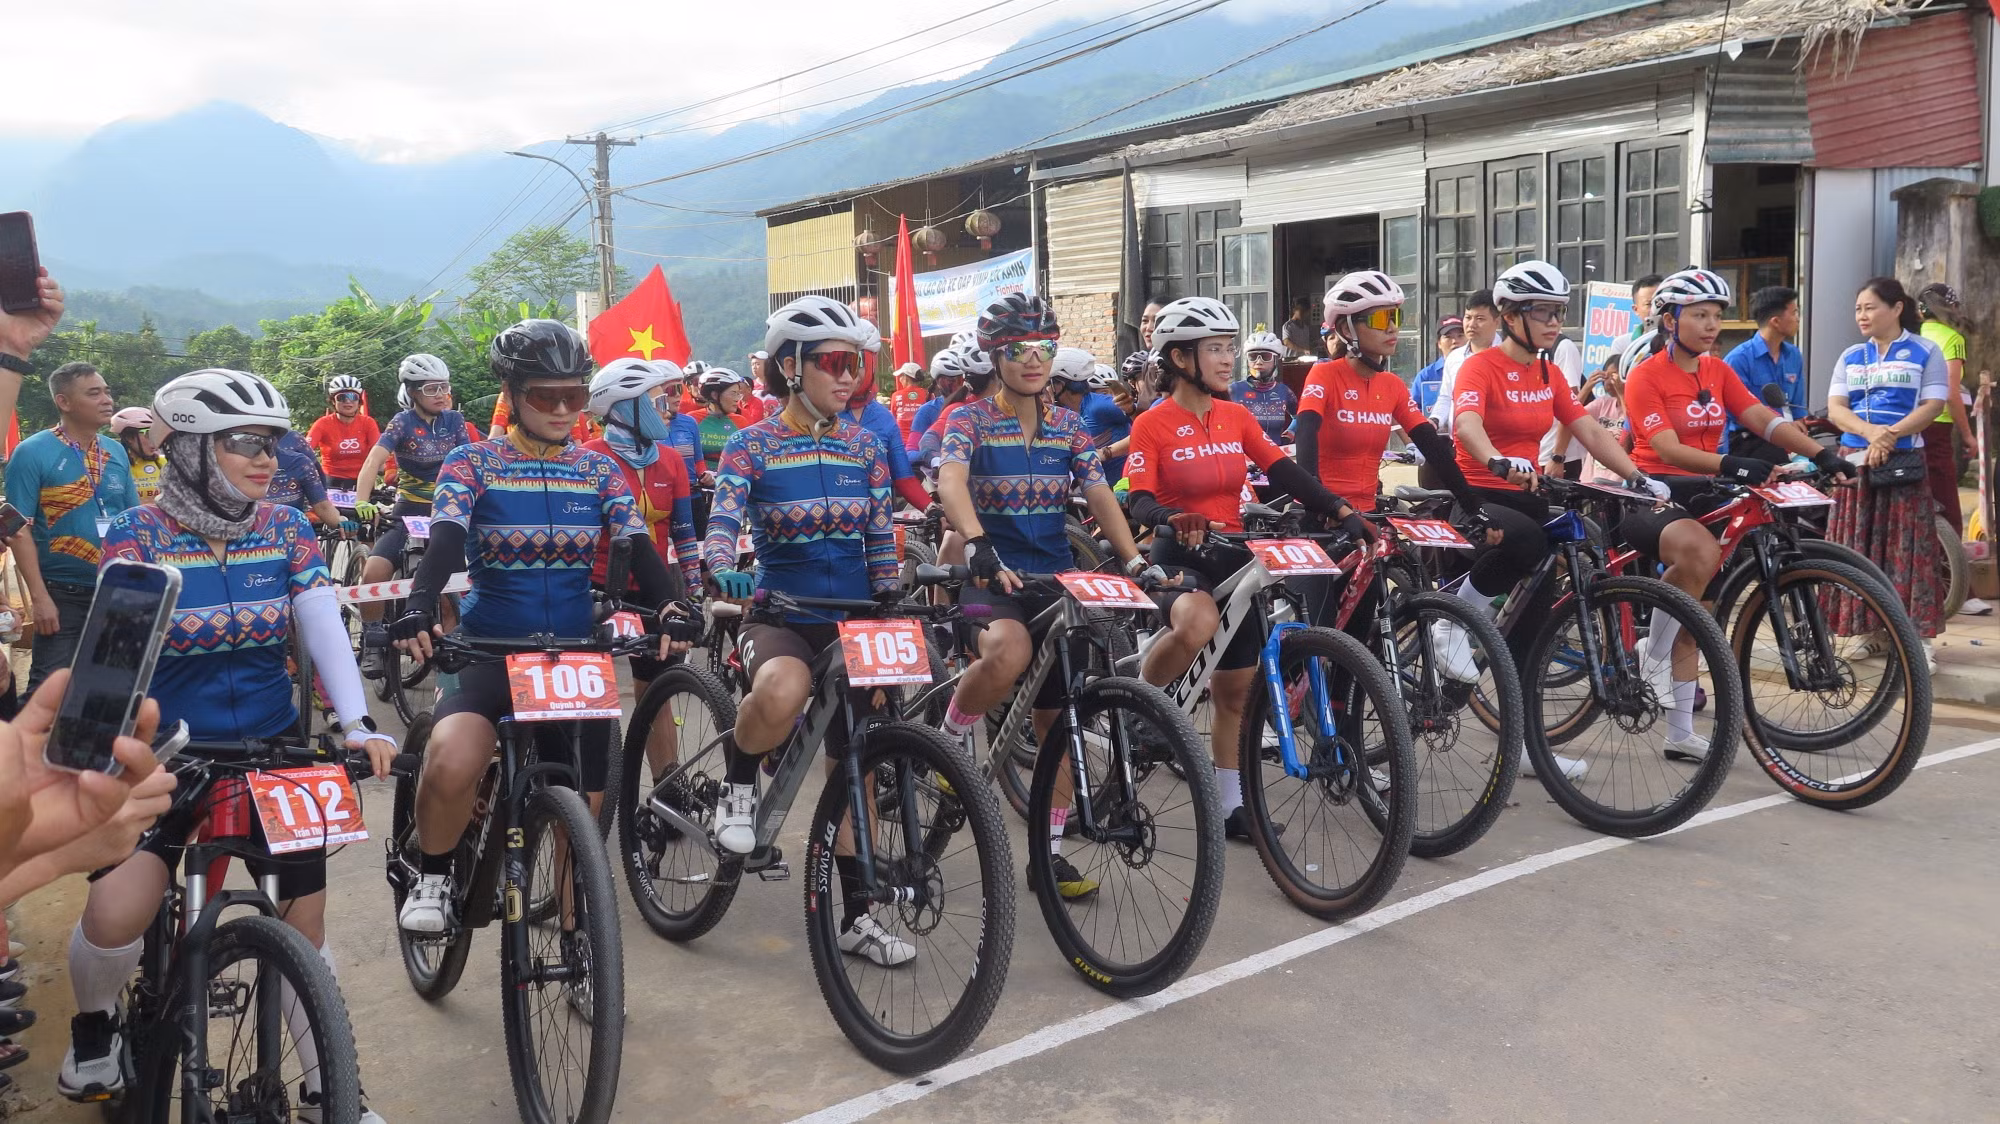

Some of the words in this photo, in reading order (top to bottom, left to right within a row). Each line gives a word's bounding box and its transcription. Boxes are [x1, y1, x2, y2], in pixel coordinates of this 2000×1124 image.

[1001, 260, 1026, 280] XANH
[1589, 303, 1630, 337] BÚN
[1887, 370, 1911, 383] Xanh
[1337, 409, 1355, 422] C5
[1357, 411, 1393, 425] HANO
[1172, 446, 1196, 461] C5
[1762, 485, 1819, 500] 102
[1402, 523, 1457, 540] 104
[1264, 545, 1323, 564] 101
[1073, 578, 1134, 598] 107
[853, 631, 918, 666] 105
[1173, 602, 1232, 709] COTT
[524, 664, 605, 700] 106
[269, 780, 350, 826] 112
[824, 820, 836, 847] DT
[632, 851, 643, 868] DT
[638, 870, 655, 899] SWISS
[818, 847, 831, 893] SWISS
[1074, 957, 1113, 984] MAXXIS
